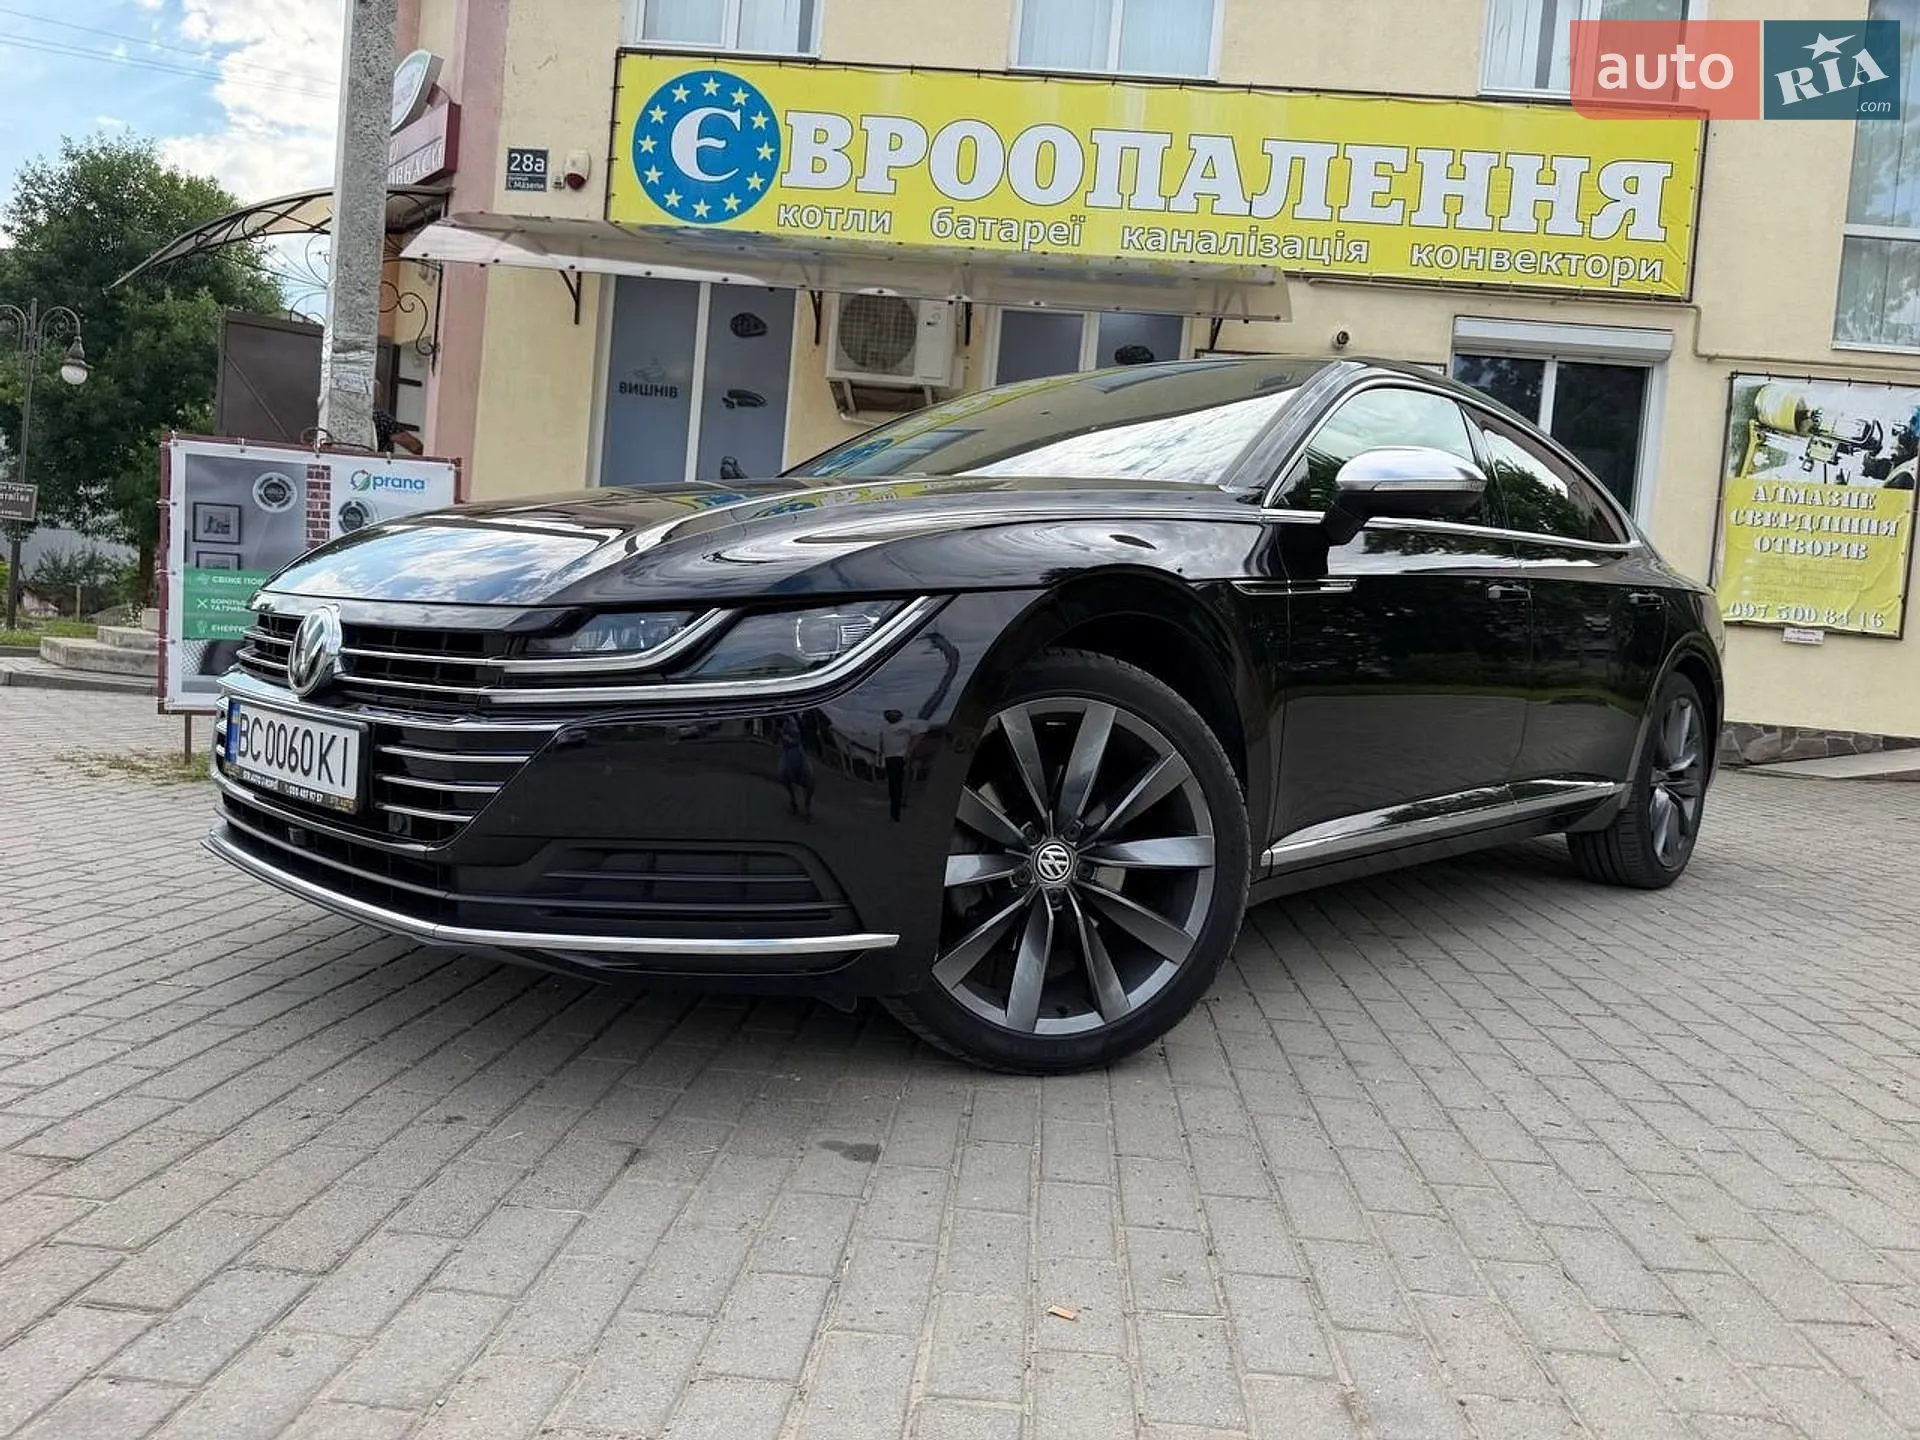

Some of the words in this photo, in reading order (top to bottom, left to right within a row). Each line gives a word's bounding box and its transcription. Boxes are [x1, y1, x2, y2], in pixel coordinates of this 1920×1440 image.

[510, 153, 545, 172] 28а
[671, 106, 1673, 242] ЄВРООПАЛЕННЯ
[776, 203, 893, 235] котли
[931, 207, 1086, 252] батареї
[1120, 222, 1371, 264] каналізація
[1410, 241, 1664, 287] конвектори
[618, 381, 679, 399] ВИШНІВ
[372, 474, 426, 490] prana
[1752, 486, 1877, 511] АЛМАЗНЕ
[1728, 508, 1899, 538] СВЕРДЛІННЯ
[1753, 535, 1869, 561] ОТВОРІВ
[1729, 602, 1769, 619] 097
[1775, 605, 1818, 622] 500
[1857, 611, 1885, 628] 16
[238, 712, 348, 788] BC0060KI
